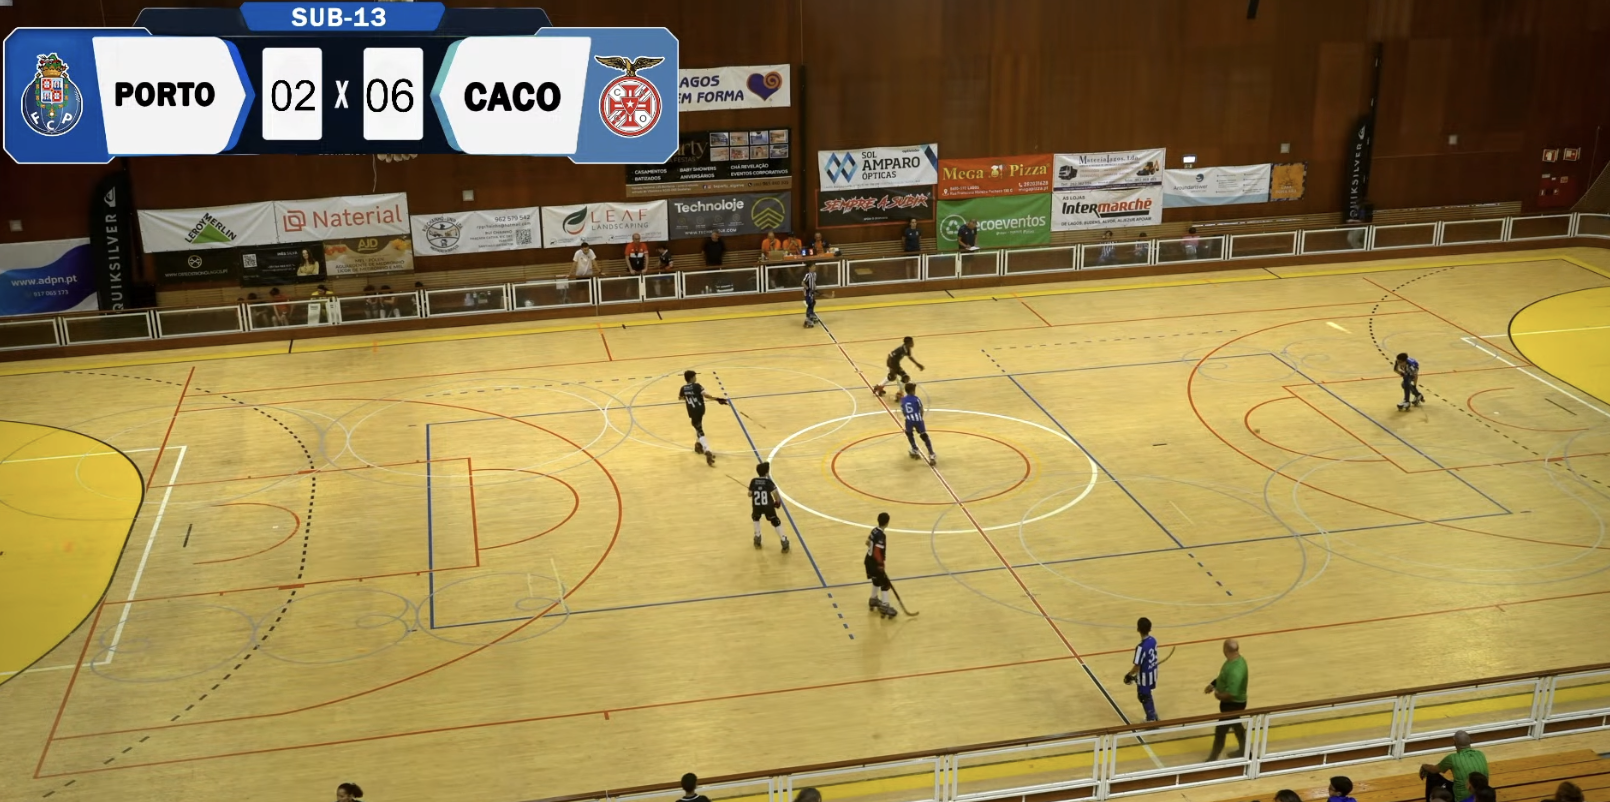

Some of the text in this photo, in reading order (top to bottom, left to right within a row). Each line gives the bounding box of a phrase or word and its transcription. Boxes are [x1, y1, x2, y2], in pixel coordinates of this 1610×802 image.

[697, 90, 744, 103] FORMA
[861, 151, 877, 159] SOL
[740, 162, 769, 170] REVELAÇÃO
[862, 156, 920, 171] AMPARO
[1009, 163, 1047, 177] Pizza
[680, 172, 715, 180] ANIVERSÁRIOS
[752, 168, 789, 176] CORPORATIVOS
[862, 170, 897, 180] ÓPTICAS
[1349, 143, 1363, 218] QUIKSILVER
[674, 198, 745, 213] Technoloje
[820, 195, 877, 214] SEMPRE
[891, 192, 928, 208] SUBIR
[313, 204, 402, 228] Naterial
[591, 208, 649, 223] LEAF
[184, 212, 237, 243] LEROY MERLIN
[591, 221, 649, 231] LANDSCAPING
[358, 238, 378, 248] AJD
[104, 214, 124, 313] QUIKSILVER
[11, 274, 78, 287] www.adpn.pt
[904, 402, 914, 413] 6
[754, 490, 768, 505] 28
